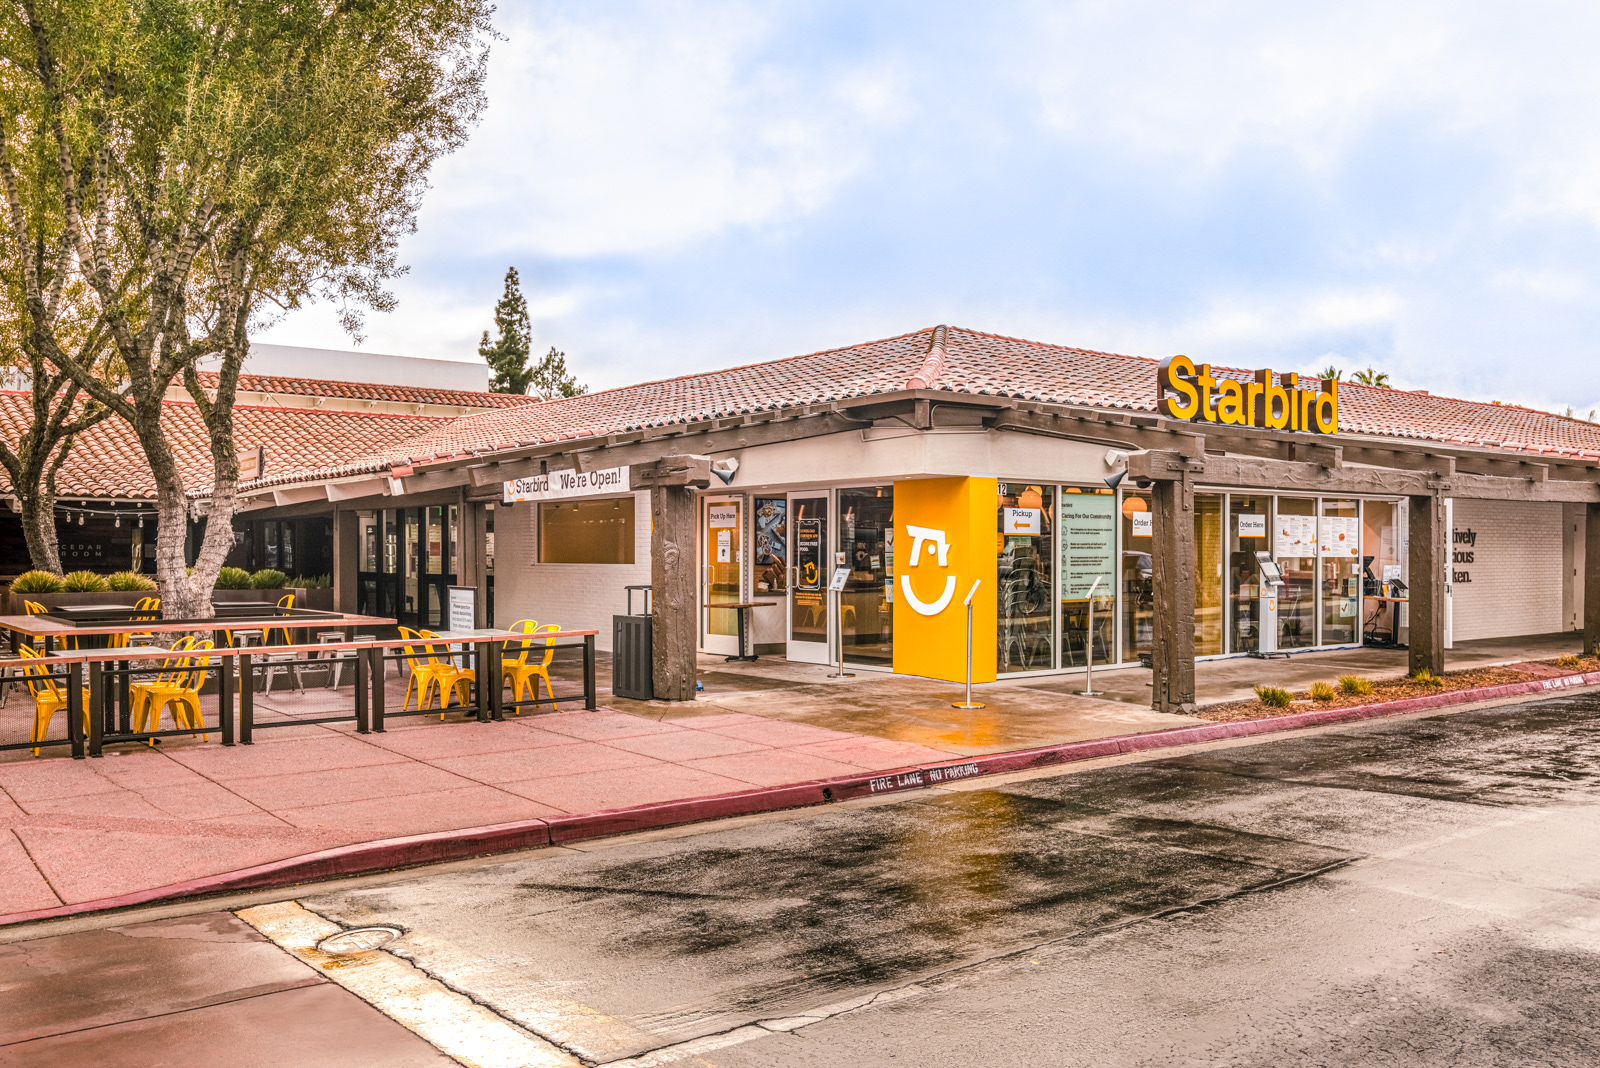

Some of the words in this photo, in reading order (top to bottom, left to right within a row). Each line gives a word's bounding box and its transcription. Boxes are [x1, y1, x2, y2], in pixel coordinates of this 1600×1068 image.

[1166, 355, 1339, 435] Starbird
[516, 476, 549, 494] Starbird
[560, 473, 587, 490] We're
[590, 467, 621, 490] Open!
[1012, 510, 1033, 519] Pickup
[1134, 518, 1149, 527] Order
[1444, 528, 1477, 547] tively
[869, 776, 894, 792] FIRE
[897, 772, 923, 787] LANE
[929, 769, 942, 782] NO
[944, 763, 979, 779] PARKING
